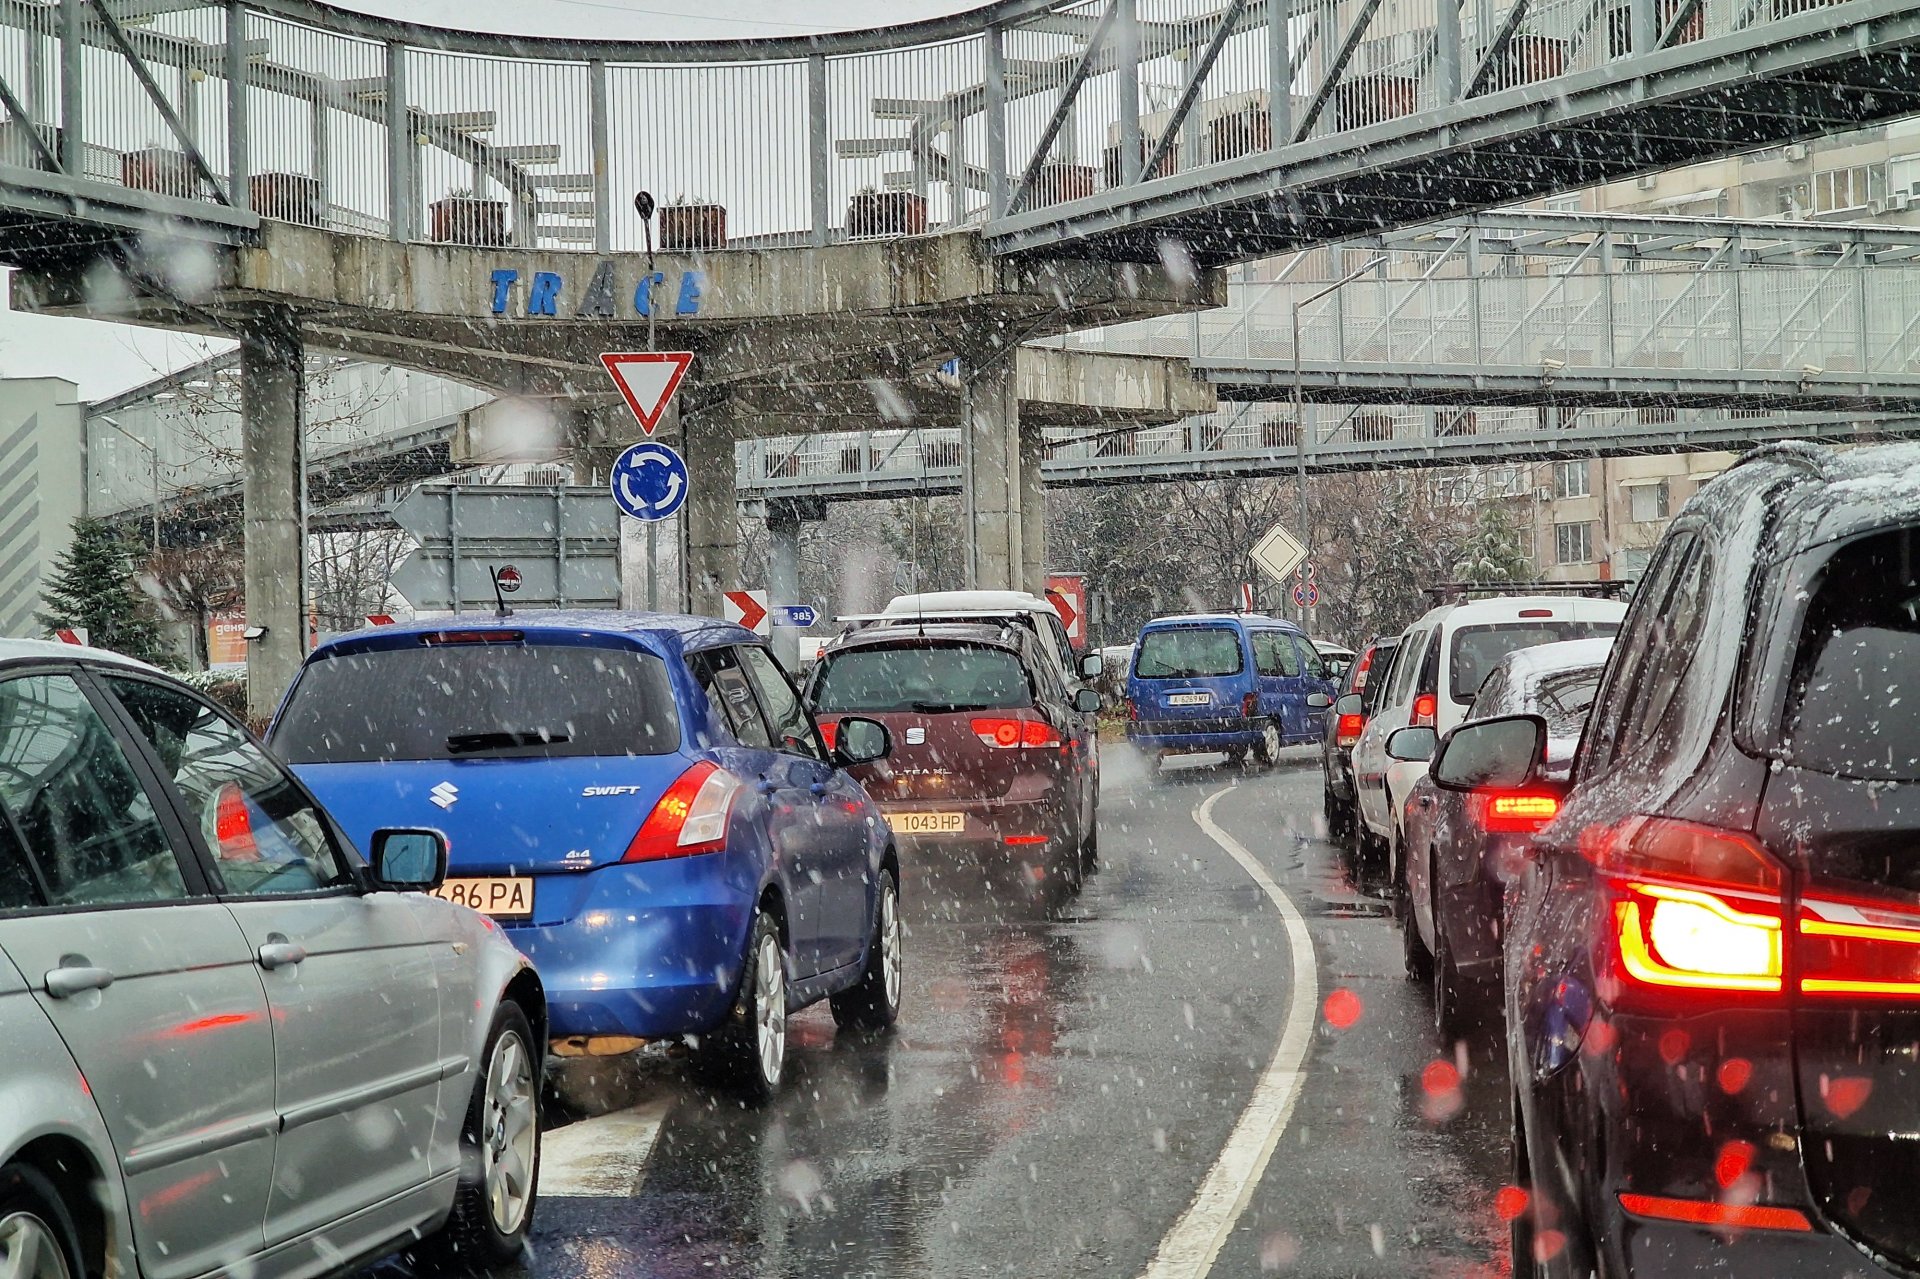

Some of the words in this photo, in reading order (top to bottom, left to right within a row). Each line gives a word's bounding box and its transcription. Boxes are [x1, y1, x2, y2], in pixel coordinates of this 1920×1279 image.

[491, 260, 705, 316] TRACE
[793, 612, 811, 621] 385
[887, 768, 930, 776] ALTEA
[582, 785, 640, 797] SWIFT
[904, 816, 938, 830] 1043
[941, 815, 960, 830] HP
[566, 849, 590, 858] 4x4
[489, 883, 525, 909] PA
